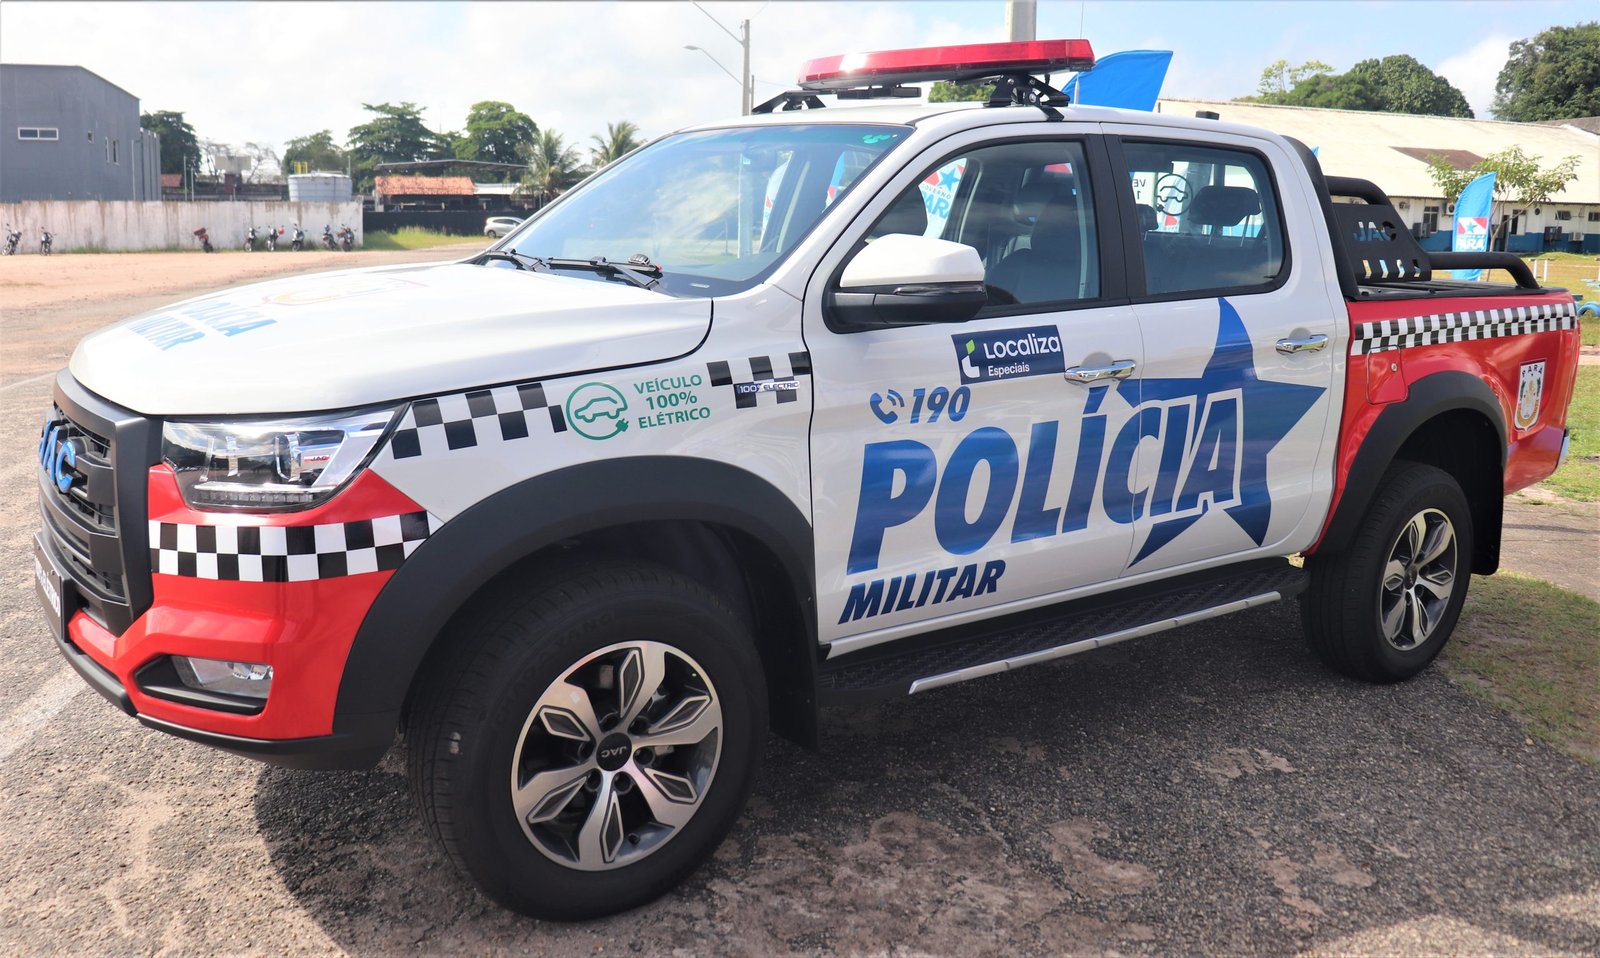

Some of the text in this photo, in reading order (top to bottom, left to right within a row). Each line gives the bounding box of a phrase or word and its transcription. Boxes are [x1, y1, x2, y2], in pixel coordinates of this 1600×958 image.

[922, 190, 949, 219] AR
[1353, 220, 1397, 241] JAC
[983, 333, 1061, 359] Localiza
[988, 362, 1030, 377] Especiais
[633, 374, 702, 395] VEÍCULO
[763, 381, 799, 391] ELECTRIC
[645, 390, 698, 410] 100%
[909, 386, 971, 424] 190
[638, 406, 711, 429] ELÉTRICO
[38, 419, 76, 493] JAC
[846, 385, 1240, 576] POLÍCIA
[837, 559, 1006, 625] MILITAR
[601, 746, 628, 758] JAC
